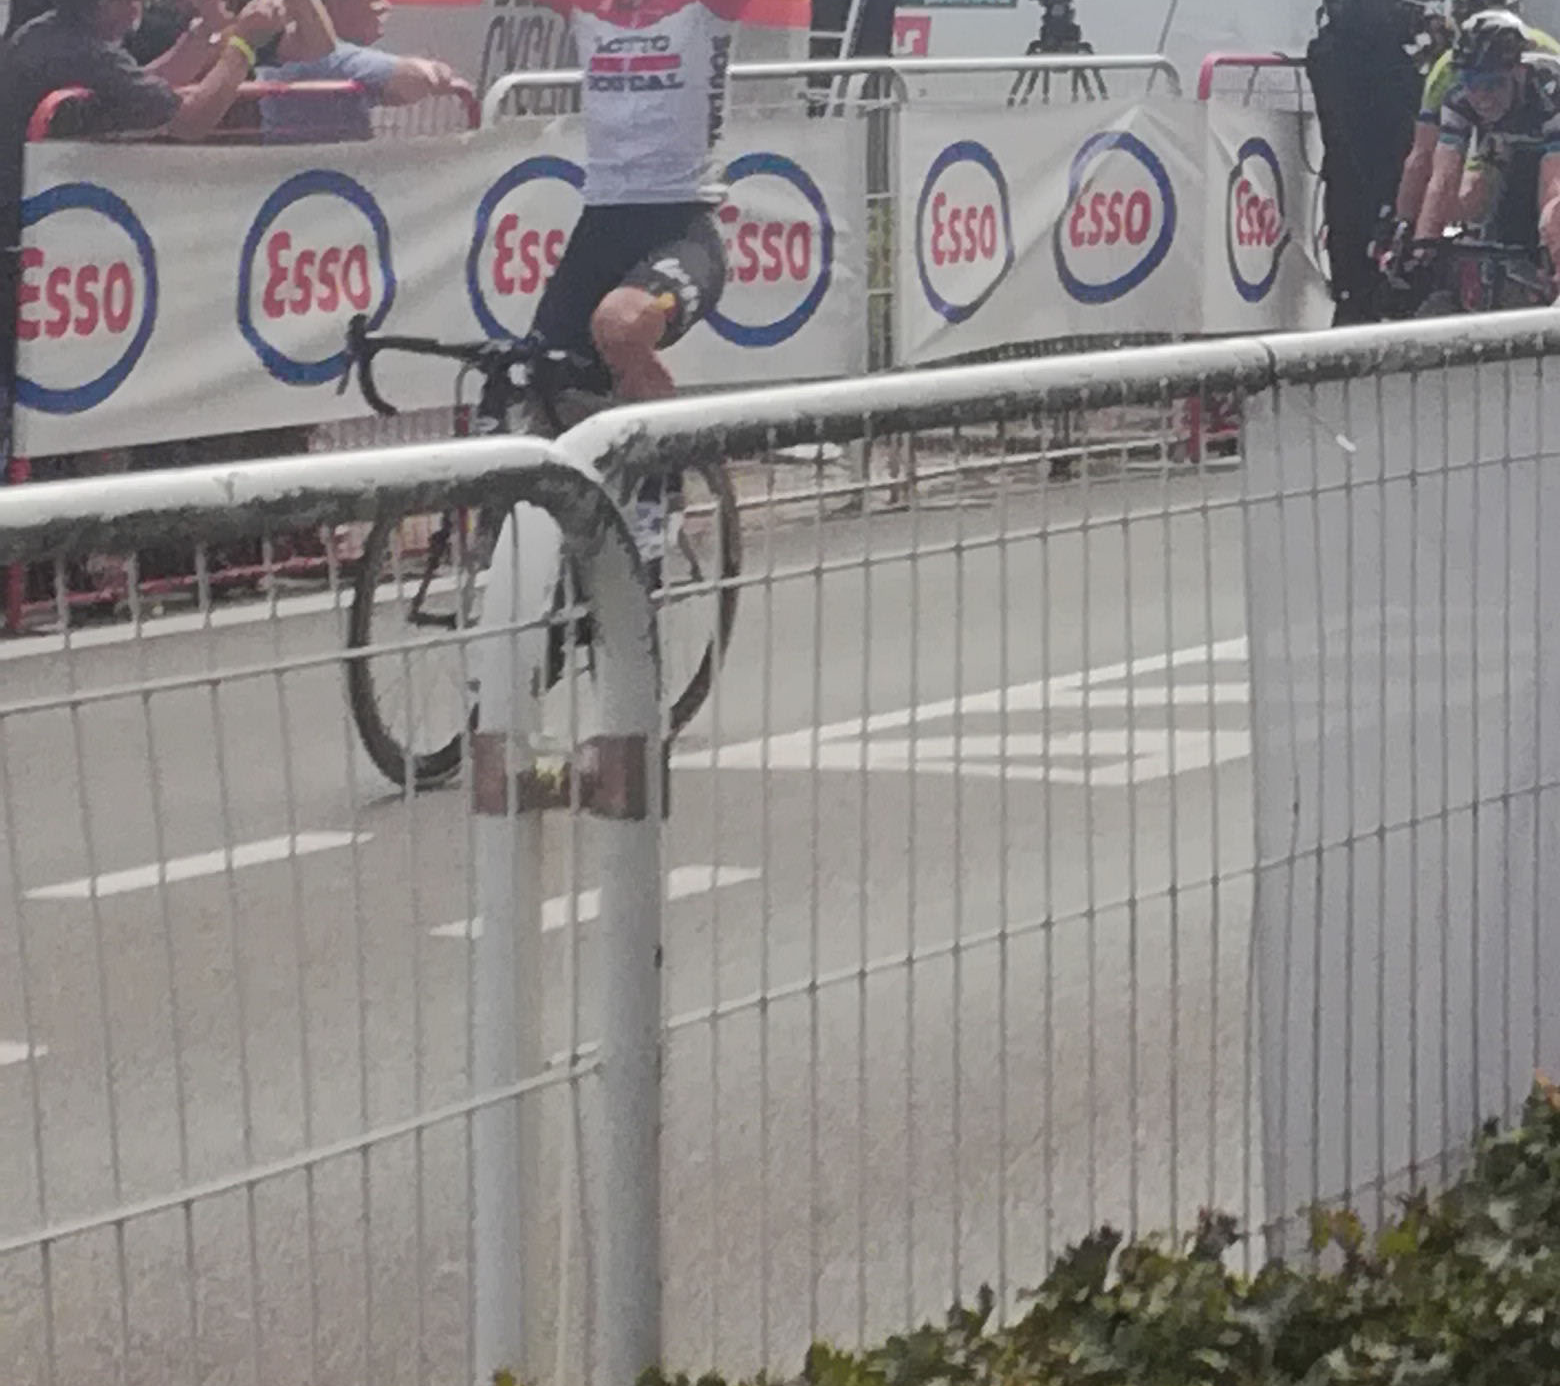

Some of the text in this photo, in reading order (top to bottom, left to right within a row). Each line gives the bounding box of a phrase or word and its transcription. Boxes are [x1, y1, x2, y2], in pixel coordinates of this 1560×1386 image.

[492, 213, 567, 295] Ess
[930, 191, 997, 267] Esso
[1069, 189, 1152, 248] Esso
[261, 230, 372, 319] Esso
